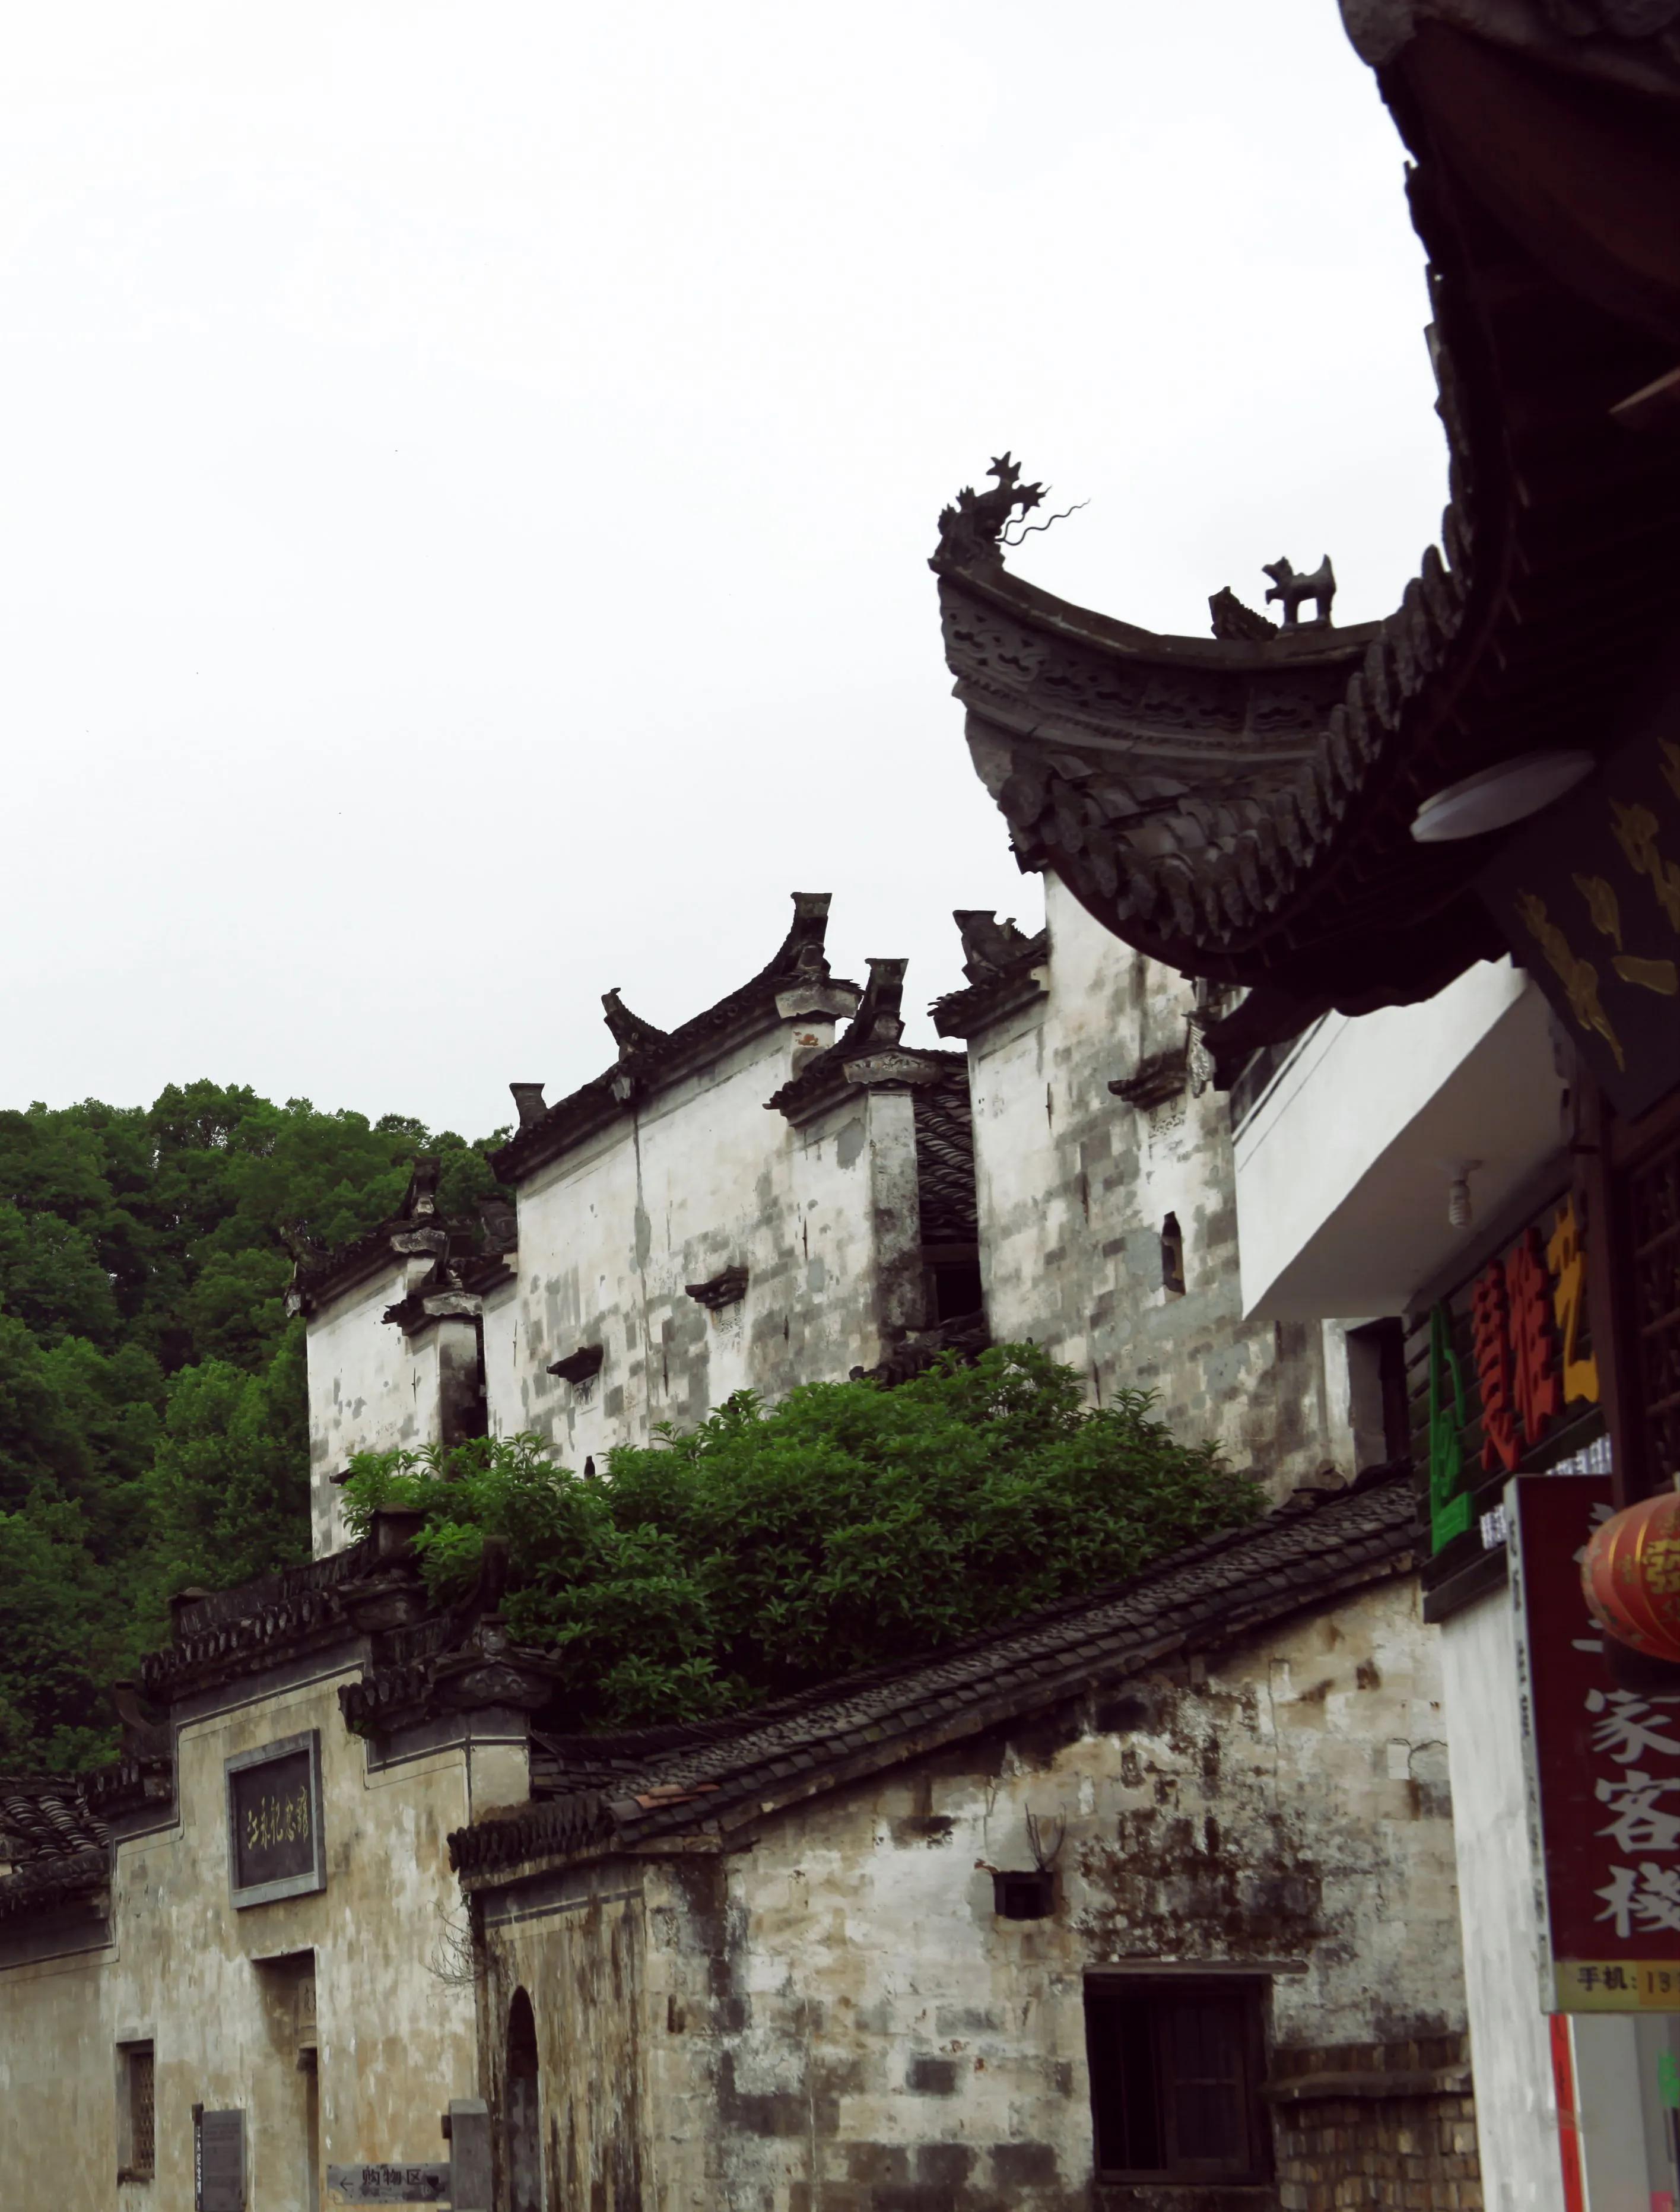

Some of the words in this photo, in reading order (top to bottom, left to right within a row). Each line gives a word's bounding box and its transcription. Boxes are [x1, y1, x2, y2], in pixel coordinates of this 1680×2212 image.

[1577, 1965, 1680, 1995] 手机:13
[362, 2166, 423, 2186] 购物区
